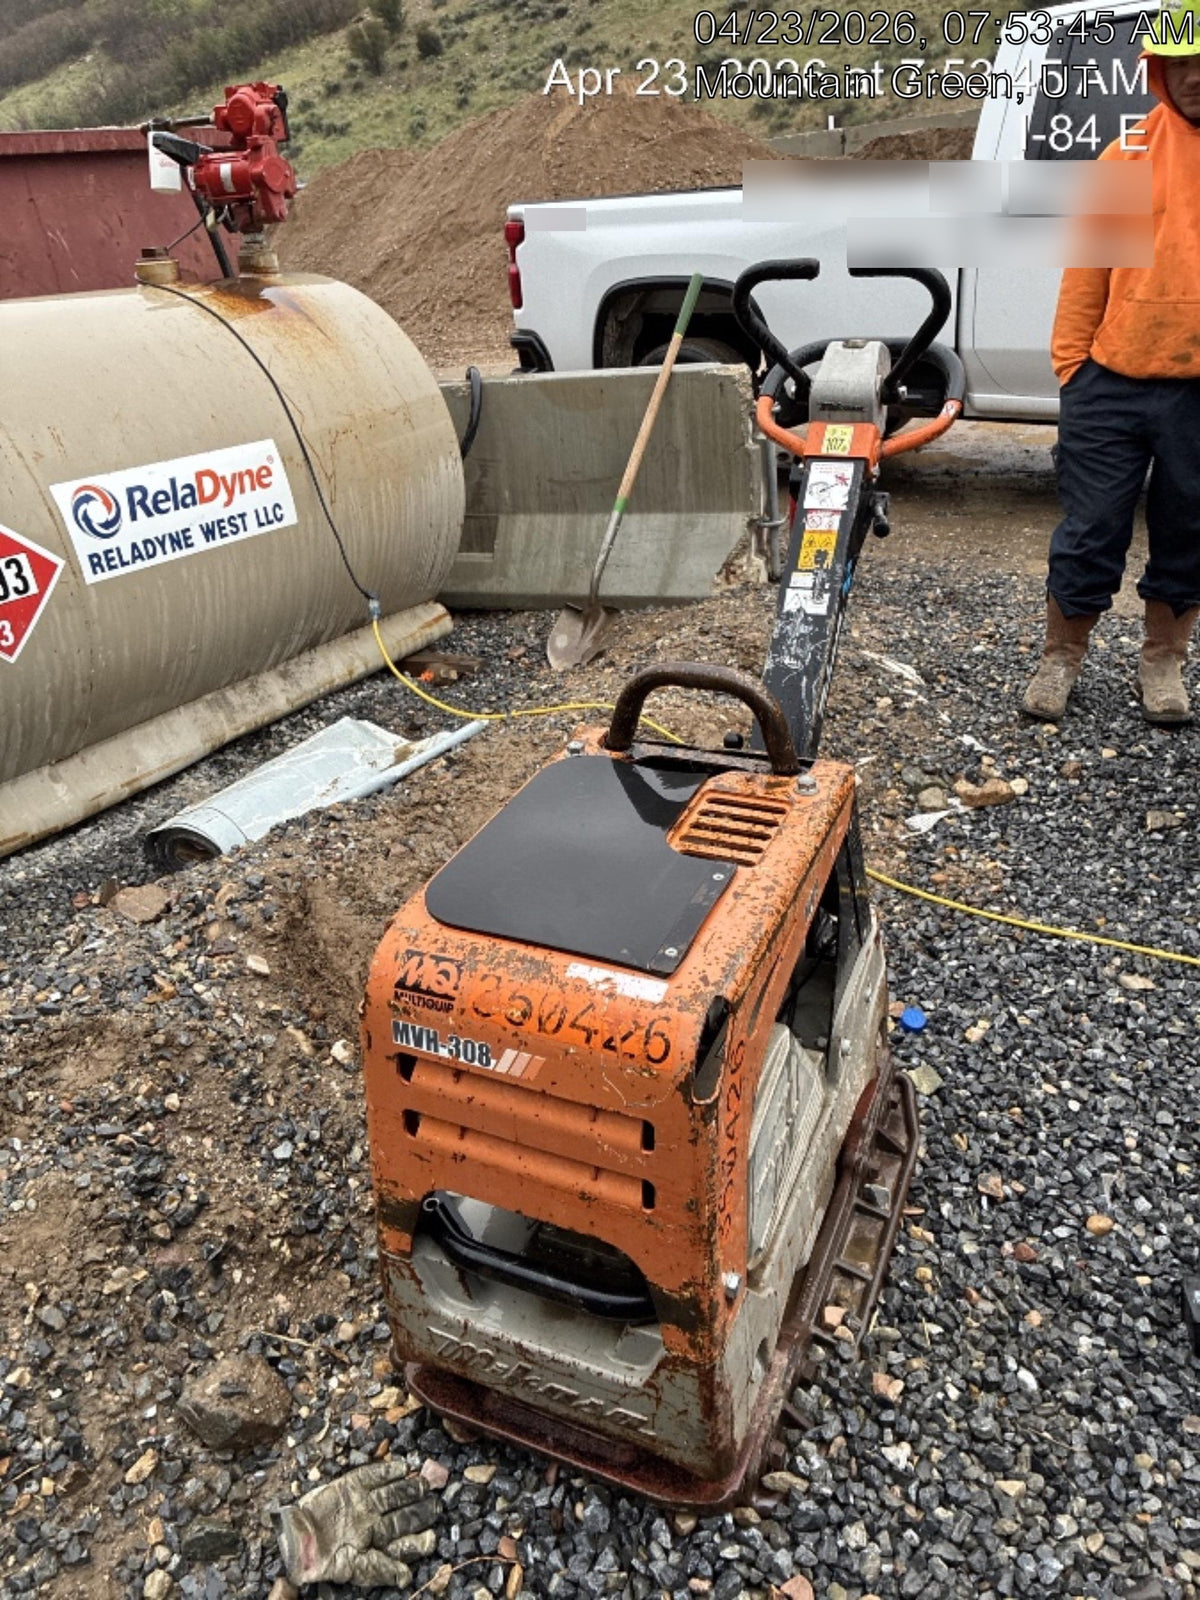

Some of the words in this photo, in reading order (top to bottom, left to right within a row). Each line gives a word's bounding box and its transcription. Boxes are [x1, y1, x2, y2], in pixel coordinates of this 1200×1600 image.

[126, 464, 273, 522] RelaDyne
[88, 527, 195, 575] RELADYNE
[199, 511, 249, 543] WEST
[255, 502, 285, 527] LLC
[0, 619, 15, 647] 3
[392, 1019, 493, 1070] MVH-308
